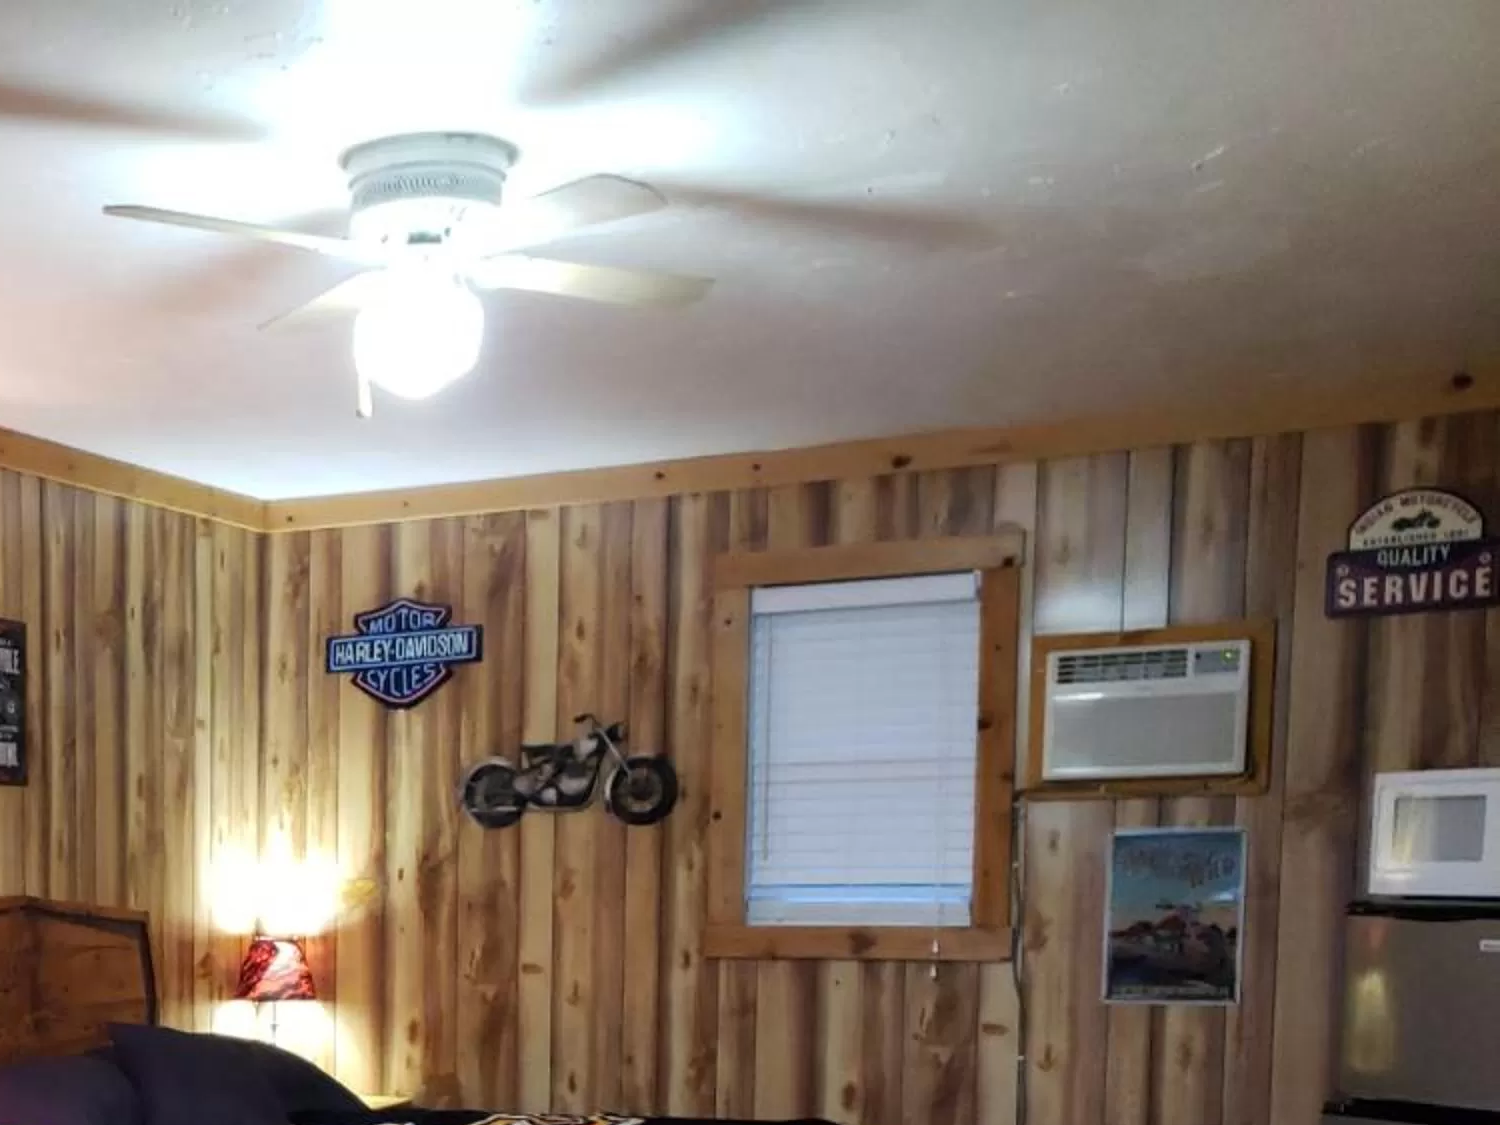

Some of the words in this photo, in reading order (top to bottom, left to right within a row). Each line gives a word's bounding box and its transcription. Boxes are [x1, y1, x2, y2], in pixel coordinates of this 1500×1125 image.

[1377, 544, 1450, 568] QUALITY
[1338, 566, 1493, 609] SERVICE
[369, 607, 437, 634] MOTOR
[334, 631, 469, 665] HARLEY-DAVIDSON
[367, 663, 437, 697] CYCLES
